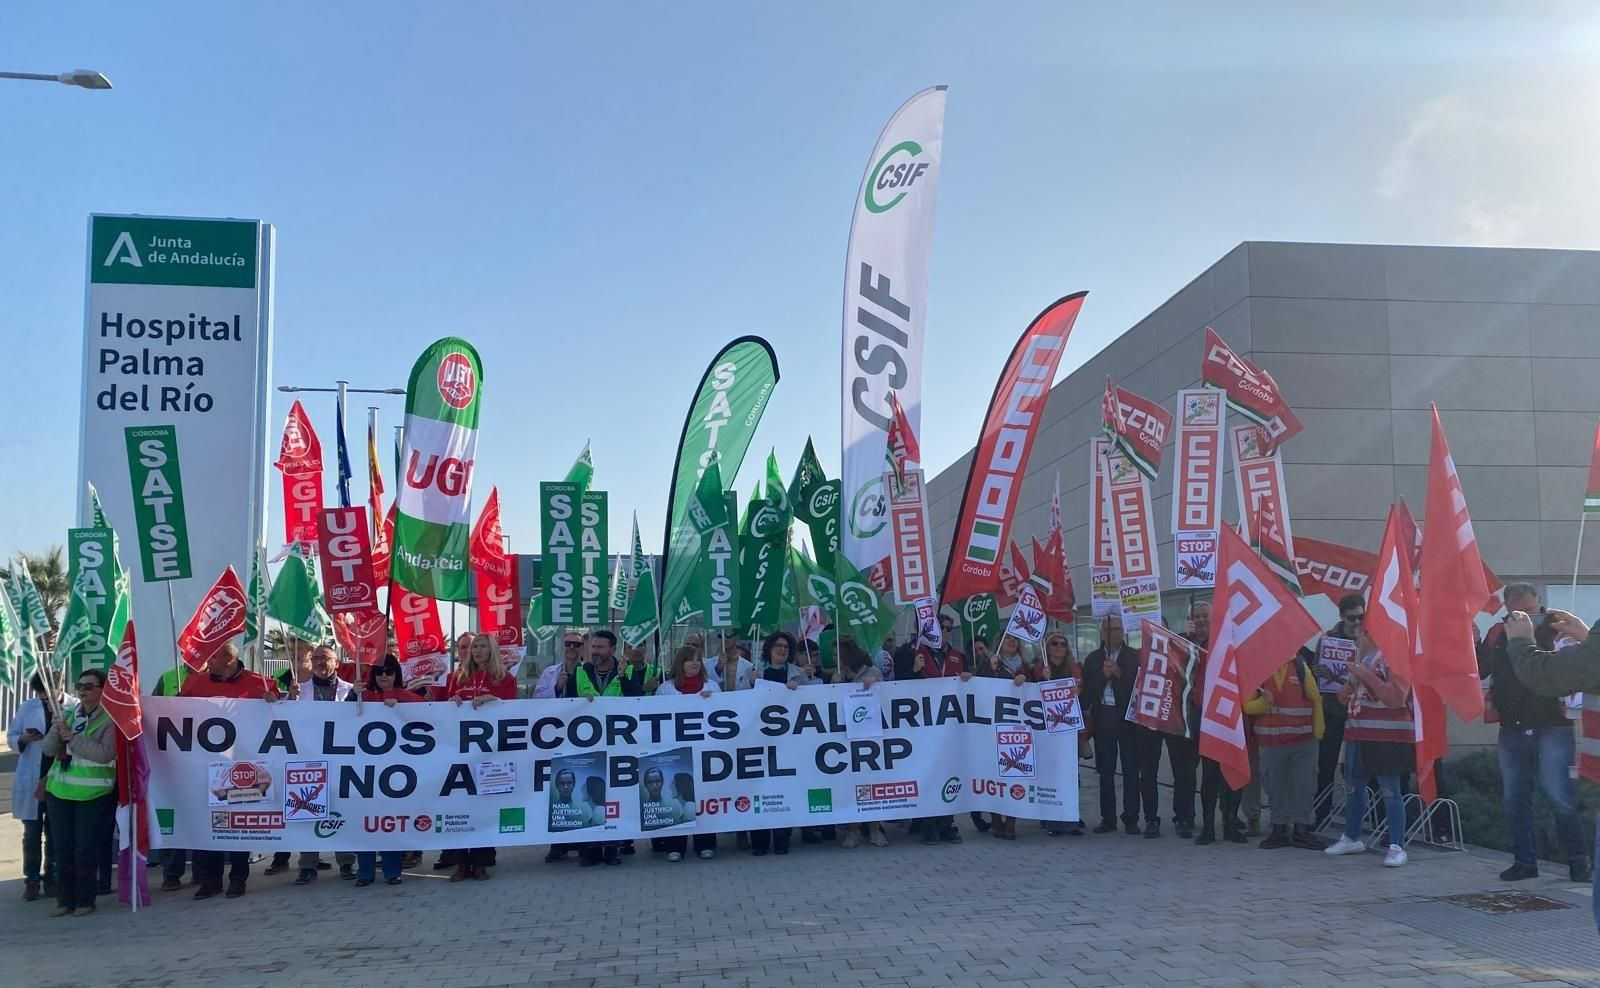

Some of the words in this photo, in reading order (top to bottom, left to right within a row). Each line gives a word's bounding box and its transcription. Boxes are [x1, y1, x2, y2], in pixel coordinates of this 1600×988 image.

[877, 162, 929, 190] CSIF
[148, 235, 192, 249] Junta
[148, 252, 166, 264] de
[171, 251, 245, 267] Andalucía
[100, 312, 242, 346] Hospital
[852, 261, 911, 432] CSIF
[100, 349, 204, 377] Palma
[97, 384, 149, 412] del
[160, 382, 214, 413] Río
[1238, 380, 1274, 404] Córdoba
[976, 334, 1063, 520] CCOO
[1185, 435, 1211, 525] CCOO
[139, 439, 180, 579] SATSE
[815, 492, 839, 509] CSIF
[1119, 492, 1146, 572] CCOO
[326, 512, 362, 582] UGT
[548, 494, 575, 623] SATSE
[898, 512, 925, 596] CCOO
[1180, 541, 1212, 552] STOP
[581, 503, 602, 624] SATSE
[708, 527, 732, 627] ATSE
[1295, 557, 1368, 590] CCOO
[750, 543, 771, 618] CSIF
[1122, 588, 1136, 598] NO
[79, 541, 107, 670] SATSE
[400, 592, 431, 636] GT
[844, 591, 878, 626] CSIF
[970, 599, 992, 613] CSIF
[413, 662, 432, 673] STOP
[1324, 648, 1352, 660] STOP
[1044, 689, 1071, 701] STOP
[156, 717, 236, 752] NO
[258, 720, 298, 754] A
[322, 721, 436, 755] LOS
[459, 709, 740, 753] RECORTES
[759, 694, 1047, 737] SALRIALES
[1000, 733, 1029, 743] STOP
[233, 771, 254, 780] STOP
[290, 771, 322, 783] STOP
[339, 764, 418, 799] NO
[701, 746, 797, 783] DEL
[815, 738, 913, 775] CRP
[875, 784, 915, 797] CCOO
[946, 784, 962, 794] CSIF
[972, 778, 1007, 798] UGT
[234, 815, 283, 826] CCOO
[320, 819, 346, 832] CSIF
[364, 815, 411, 833] UGT
